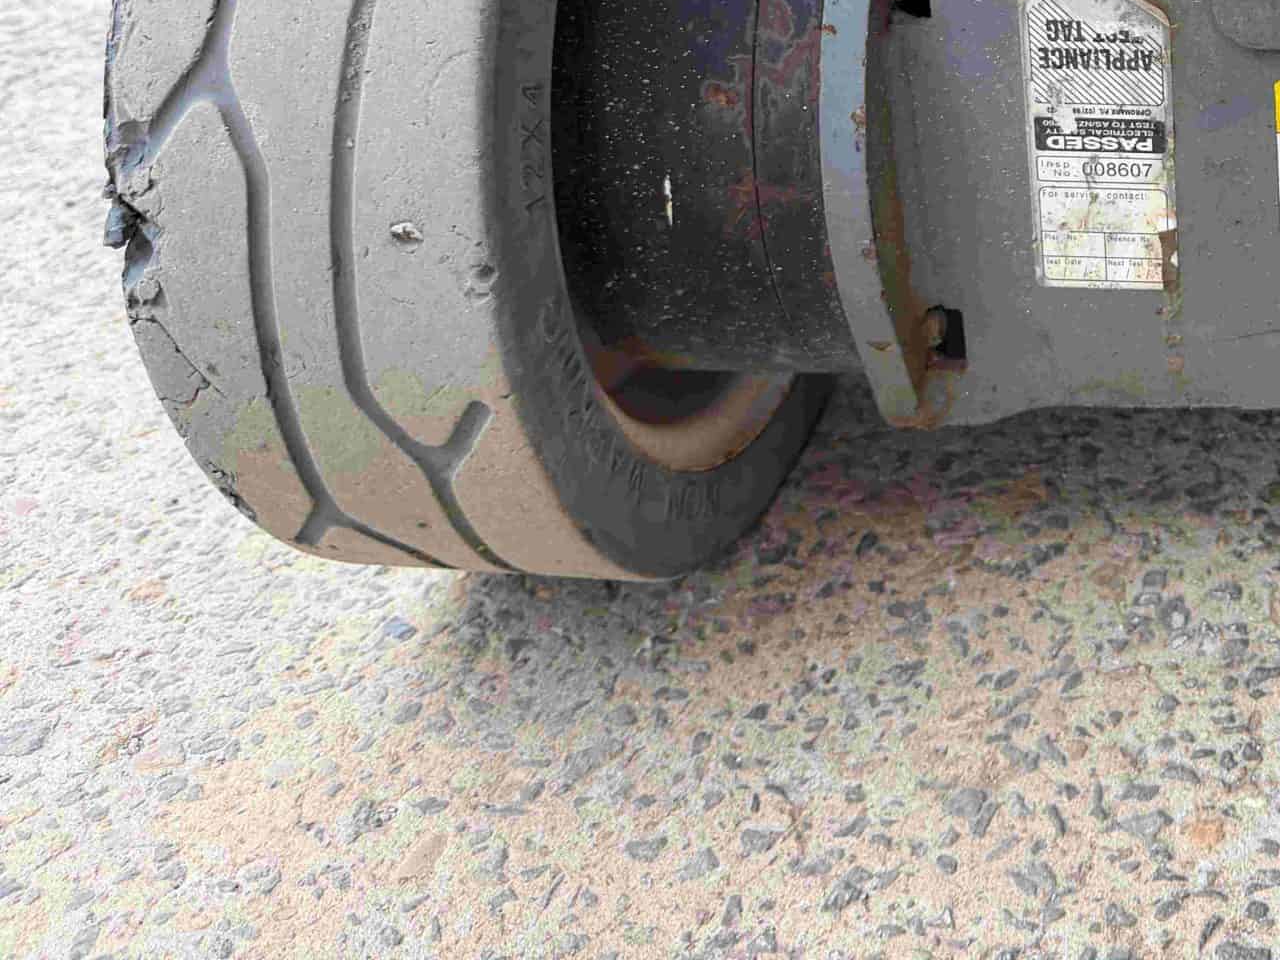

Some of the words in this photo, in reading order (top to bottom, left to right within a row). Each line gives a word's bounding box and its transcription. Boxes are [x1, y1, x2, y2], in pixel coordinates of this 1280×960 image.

[1045, 19, 1085, 43] TAG
[1038, 47, 1153, 71] APPLIANCE
[1046, 136, 1153, 151] PASSED
[1082, 161, 1153, 178] 008607
